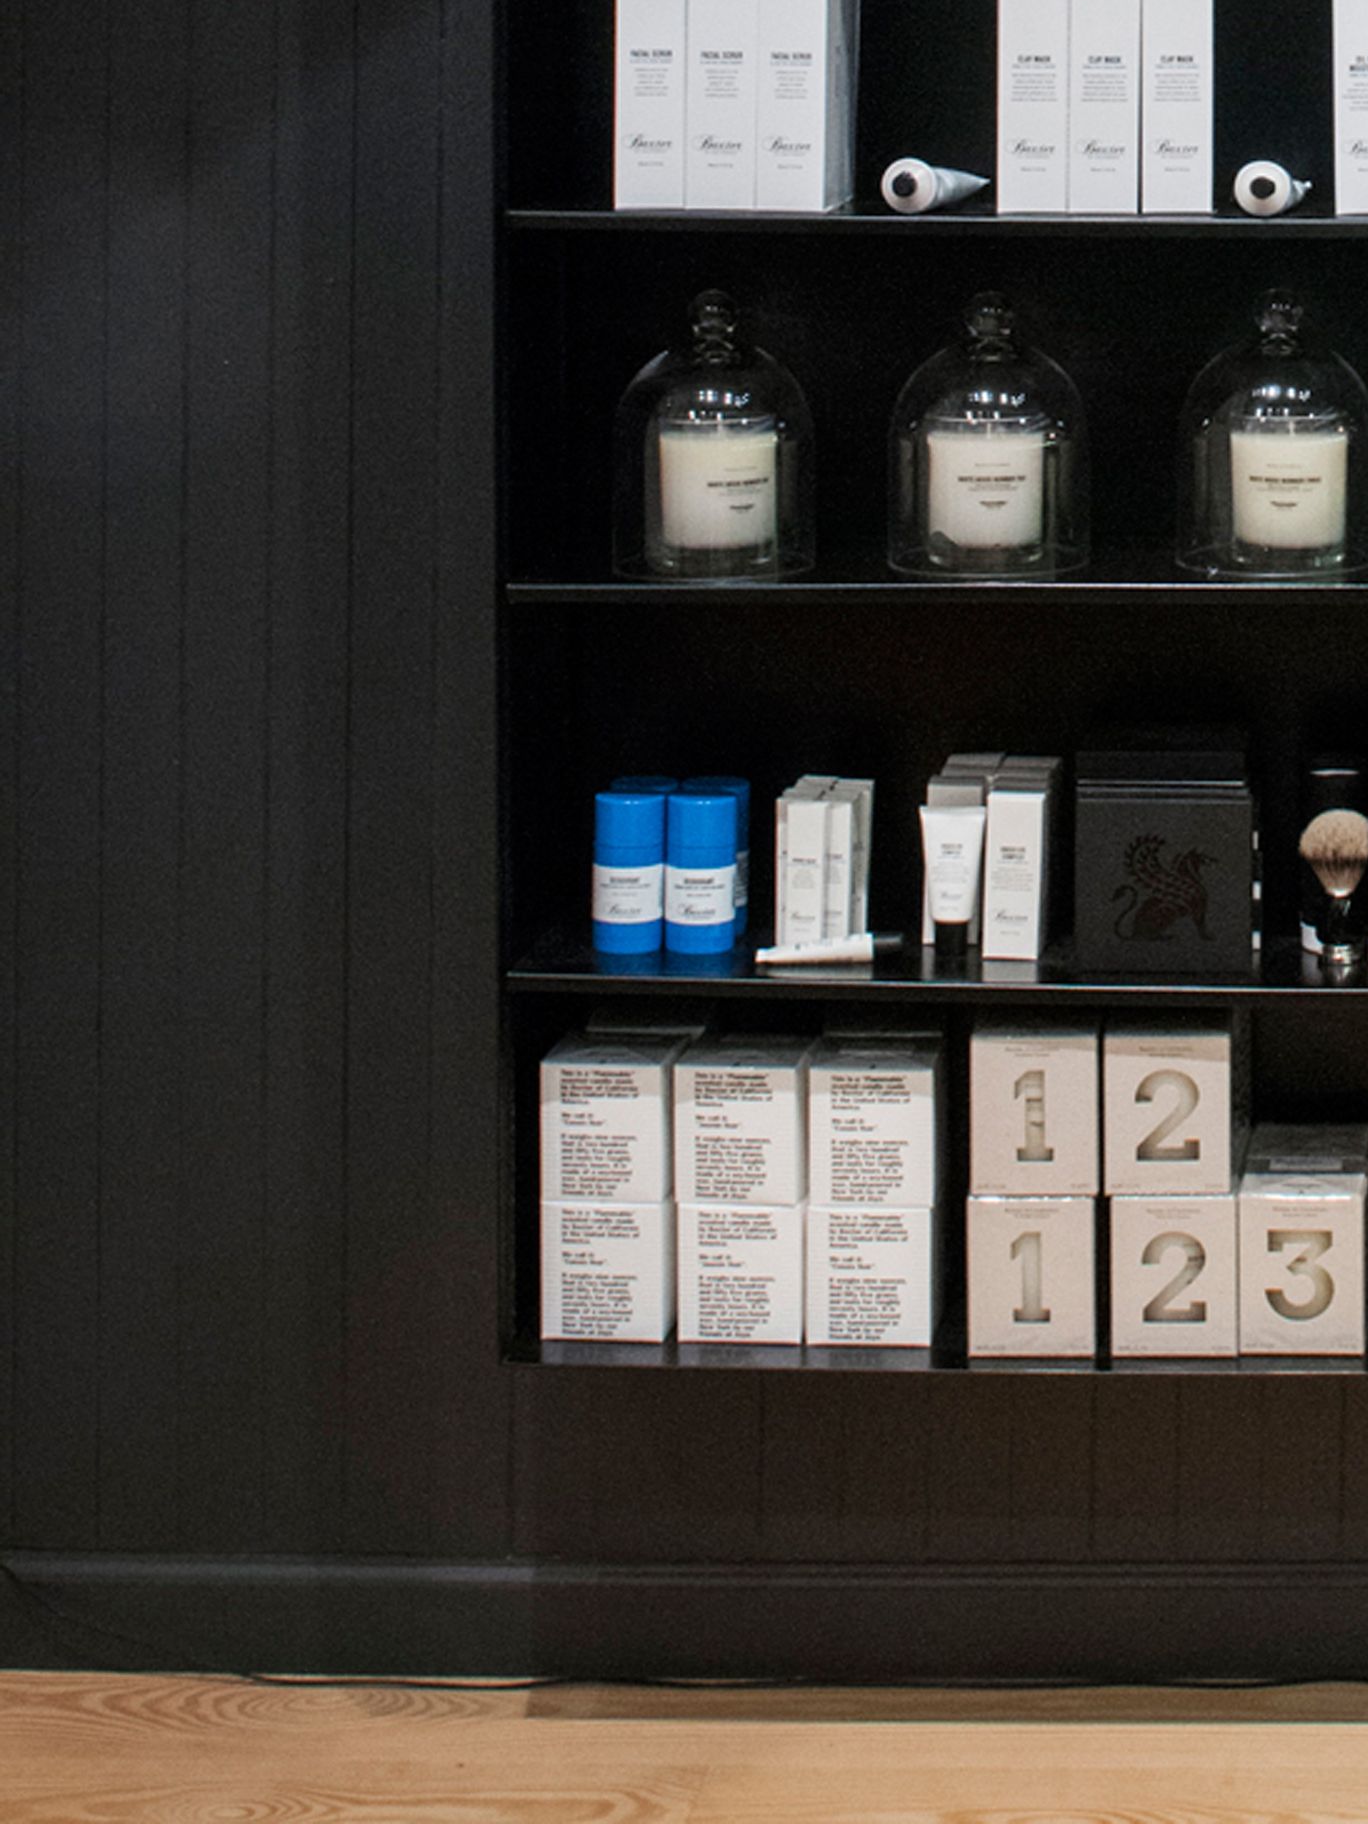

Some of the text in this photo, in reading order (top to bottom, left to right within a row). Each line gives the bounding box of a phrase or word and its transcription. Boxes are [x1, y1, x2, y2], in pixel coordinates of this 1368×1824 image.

[1014, 1069, 1054, 1161] 1
[1134, 1069, 1200, 1161] 2
[1010, 1230, 1051, 1323] 1
[1141, 1230, 1206, 1323] 2
[1264, 1229, 1335, 1321] 3
